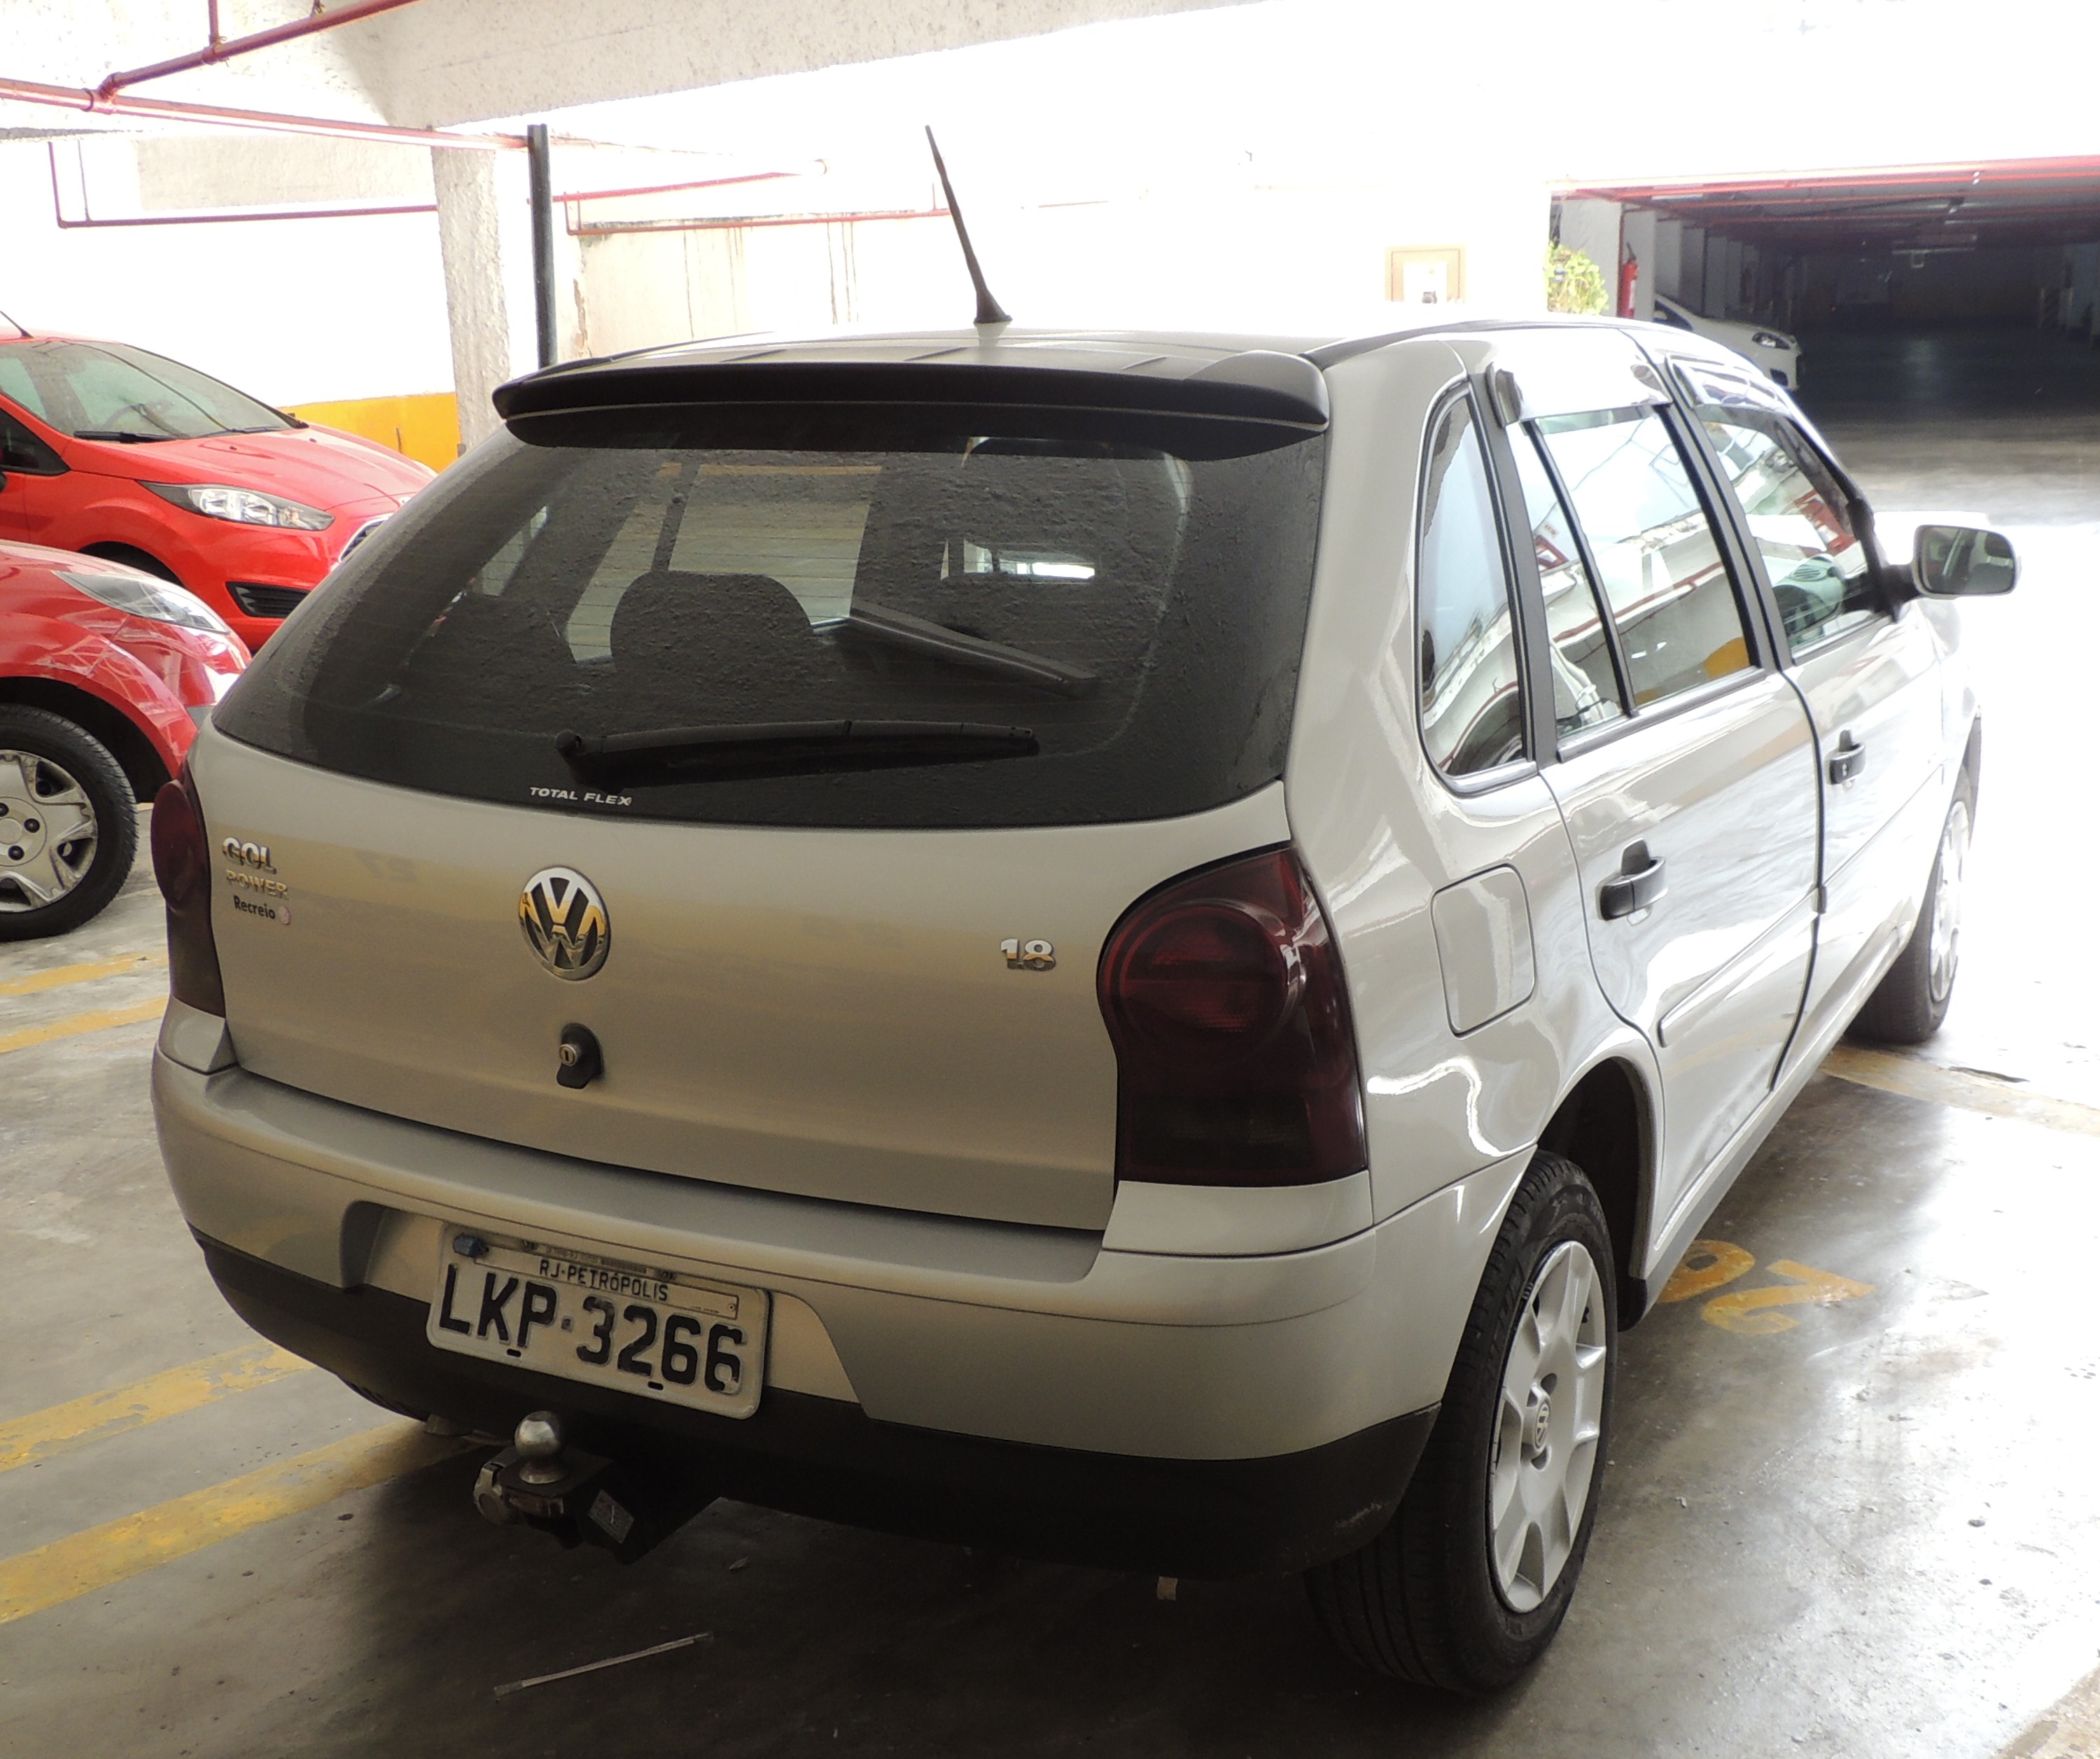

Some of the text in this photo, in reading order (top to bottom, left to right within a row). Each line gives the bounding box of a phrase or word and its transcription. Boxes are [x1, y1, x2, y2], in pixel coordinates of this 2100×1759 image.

[530, 787, 633, 806] TOTAL FLEX
[222, 837, 277, 874] GOL
[225, 869, 289, 901] POWER
[233, 895, 276, 920] Recreio
